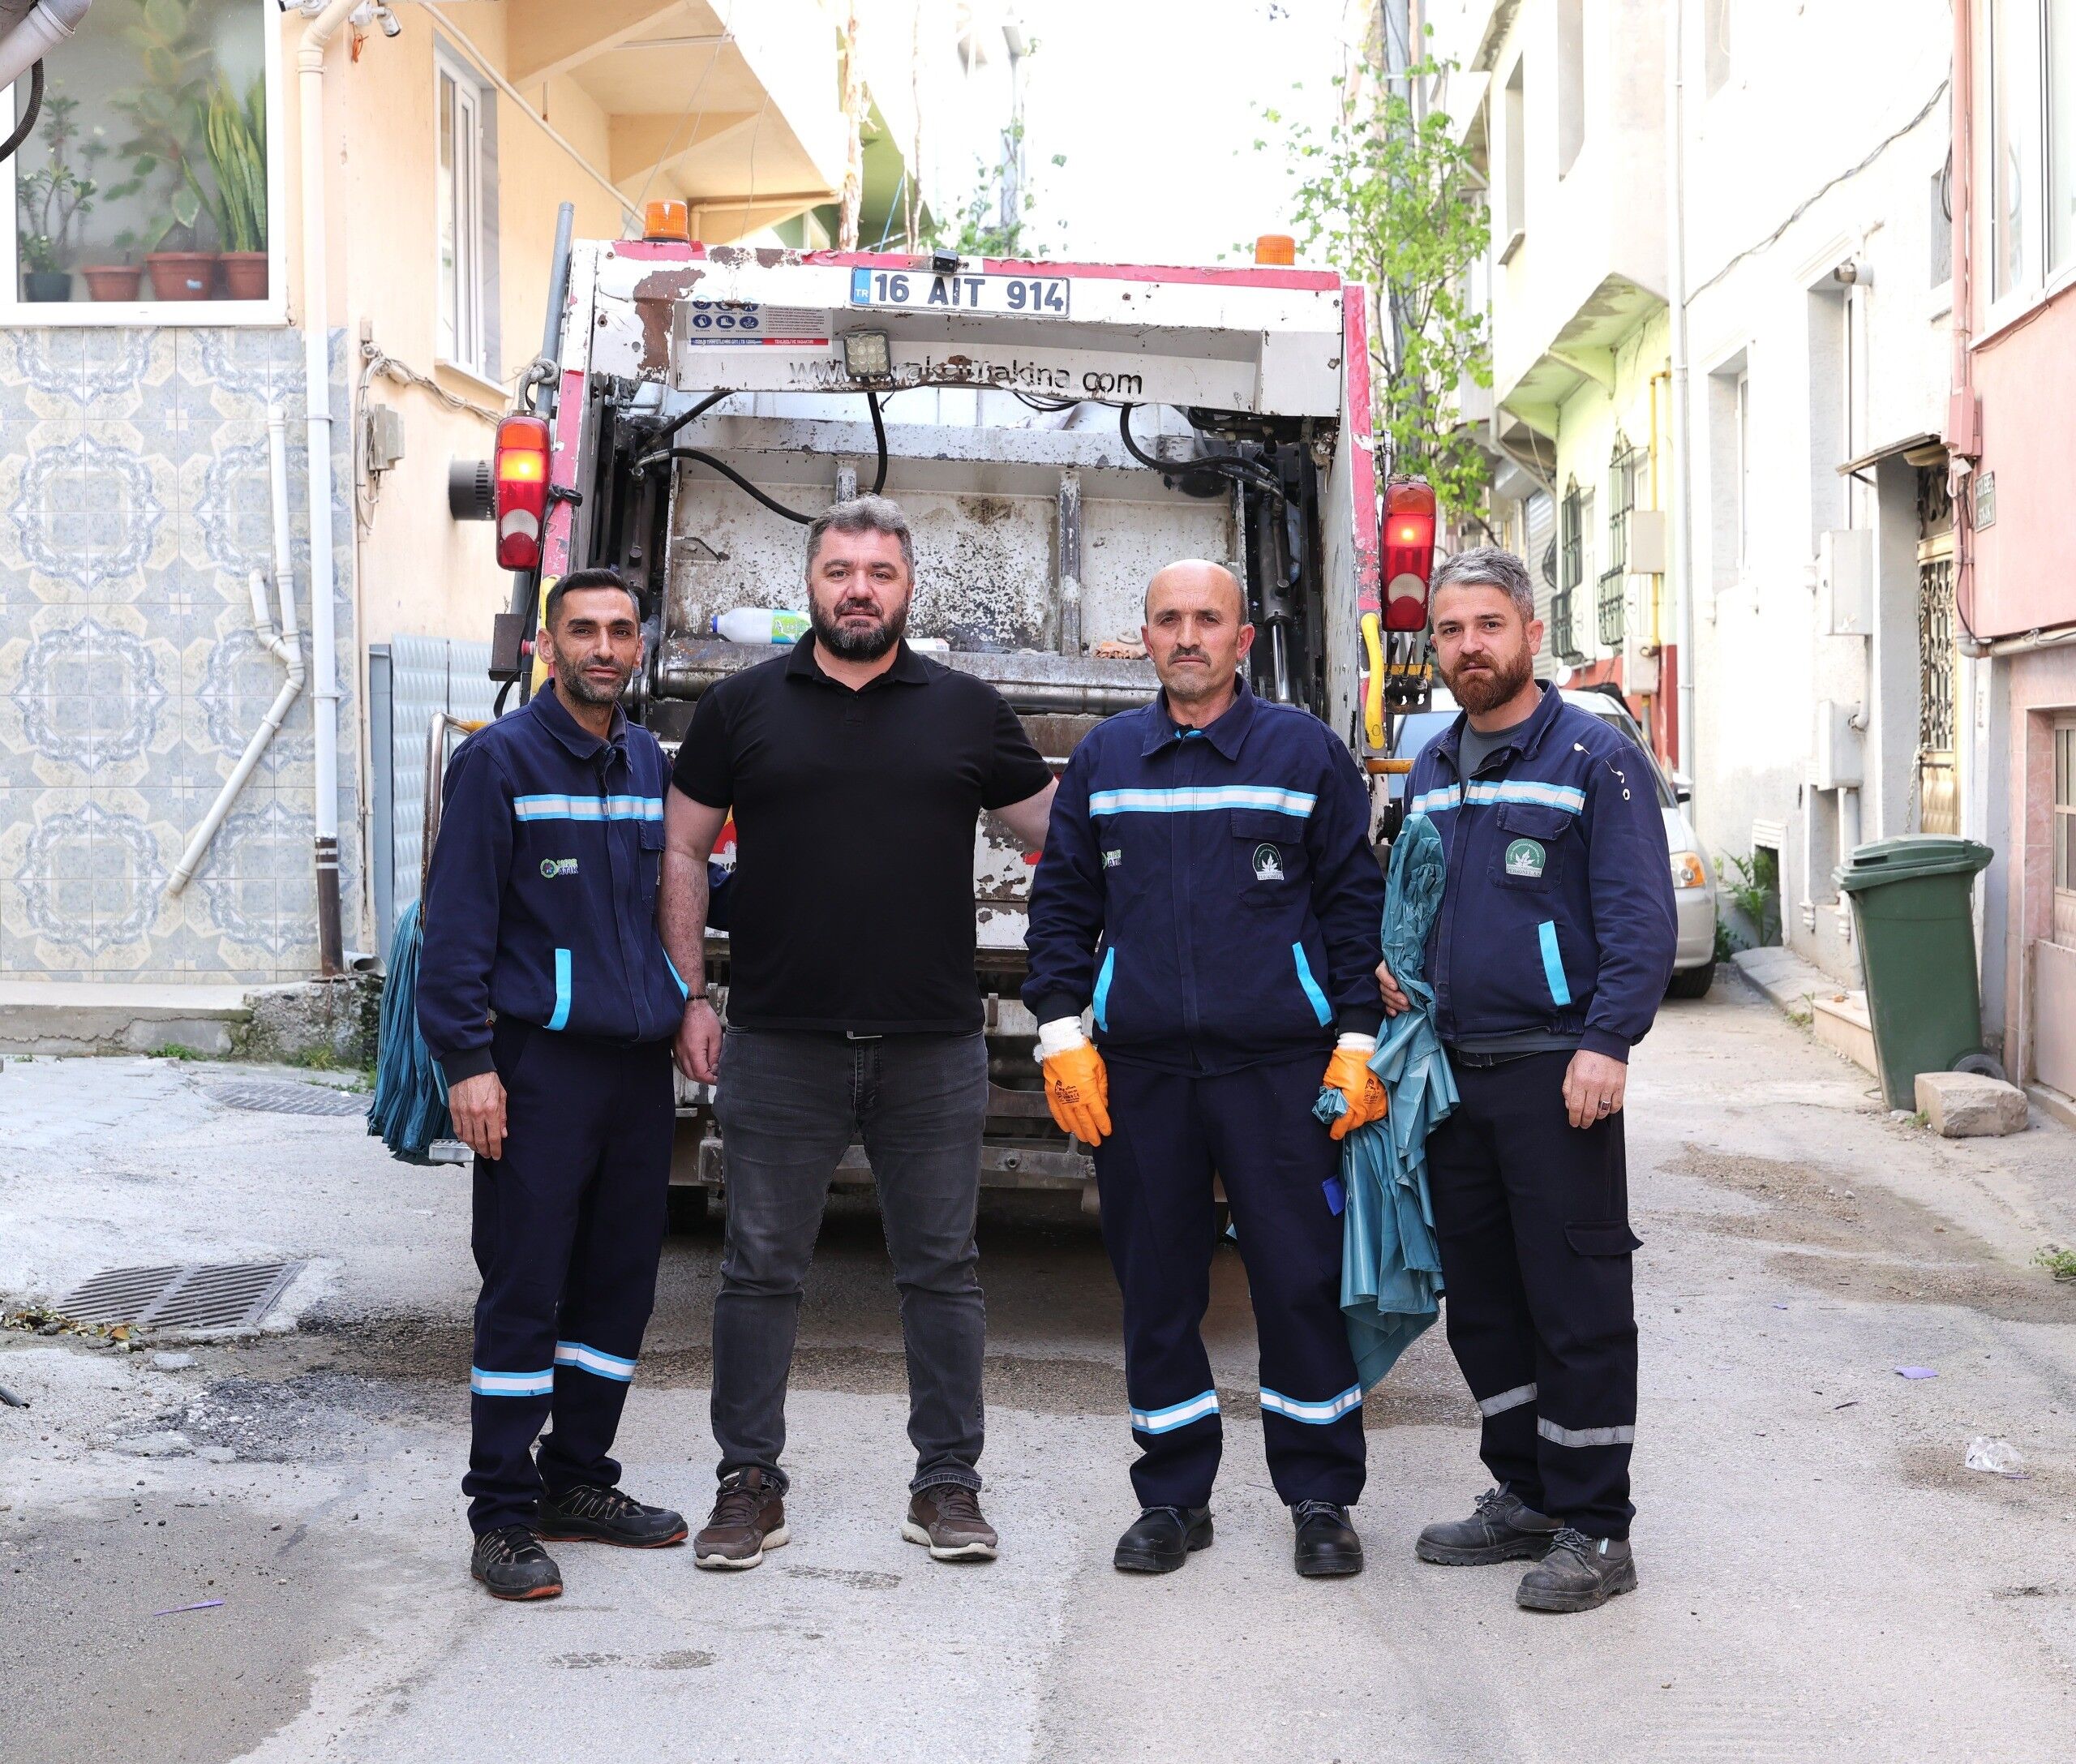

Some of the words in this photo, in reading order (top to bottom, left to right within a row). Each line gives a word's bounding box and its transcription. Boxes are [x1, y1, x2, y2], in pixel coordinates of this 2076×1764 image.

[855, 288, 869, 298] TR
[874, 273, 910, 303] 16
[927, 276, 986, 307] AIT
[1006, 281, 1064, 311] 914
